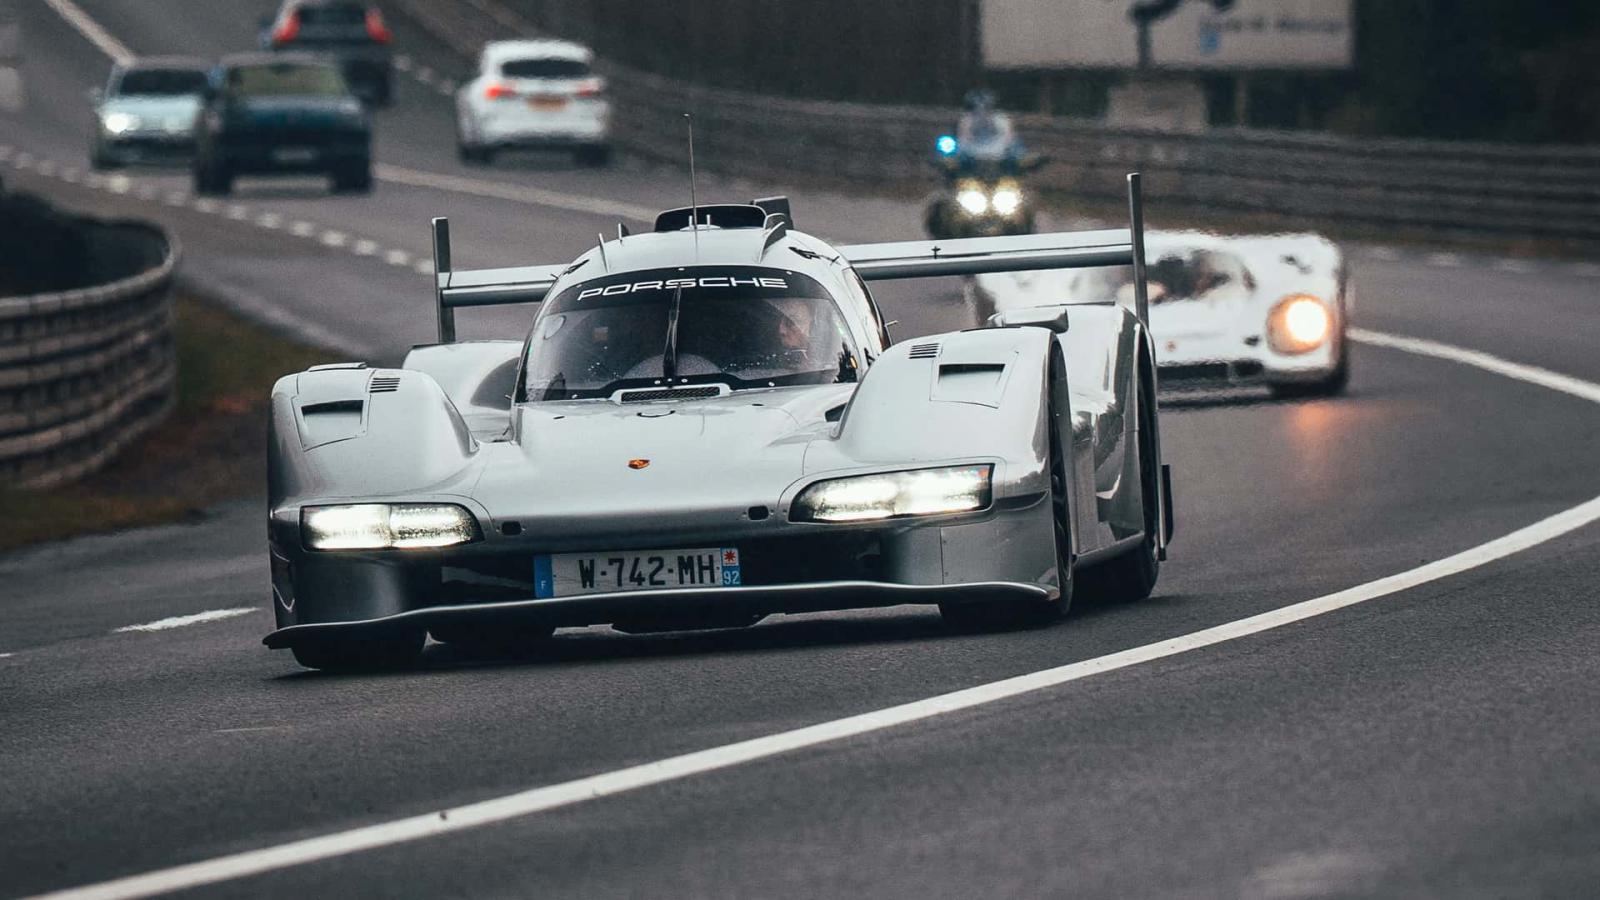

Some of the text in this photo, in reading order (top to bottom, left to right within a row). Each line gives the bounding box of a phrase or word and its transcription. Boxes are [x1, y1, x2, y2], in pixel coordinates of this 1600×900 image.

[577, 277, 788, 301] PORSCHE
[541, 580, 547, 591] F
[723, 570, 741, 586] 92
